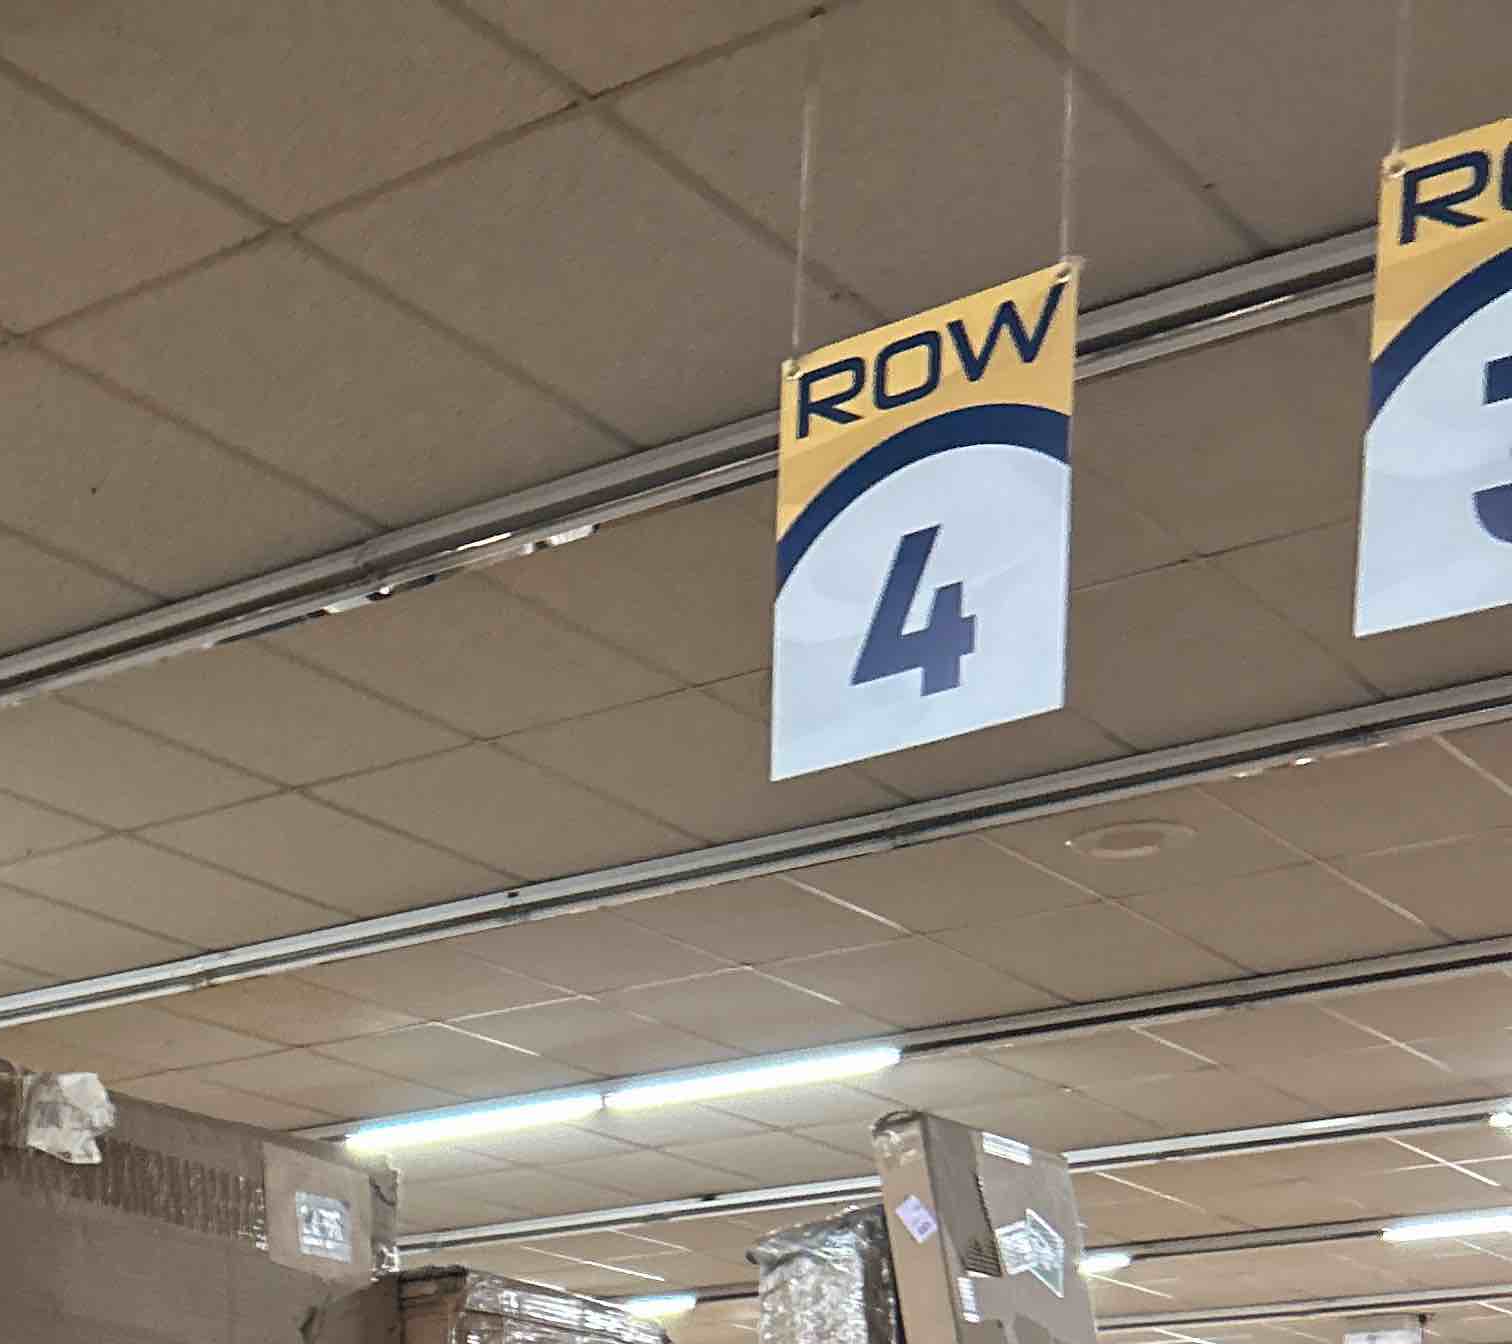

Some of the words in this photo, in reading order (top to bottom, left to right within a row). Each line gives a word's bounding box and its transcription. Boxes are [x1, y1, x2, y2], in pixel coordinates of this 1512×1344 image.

[1398, 149, 1512, 246] R
[796, 282, 1068, 441] ROW
[849, 524, 979, 699] 4
